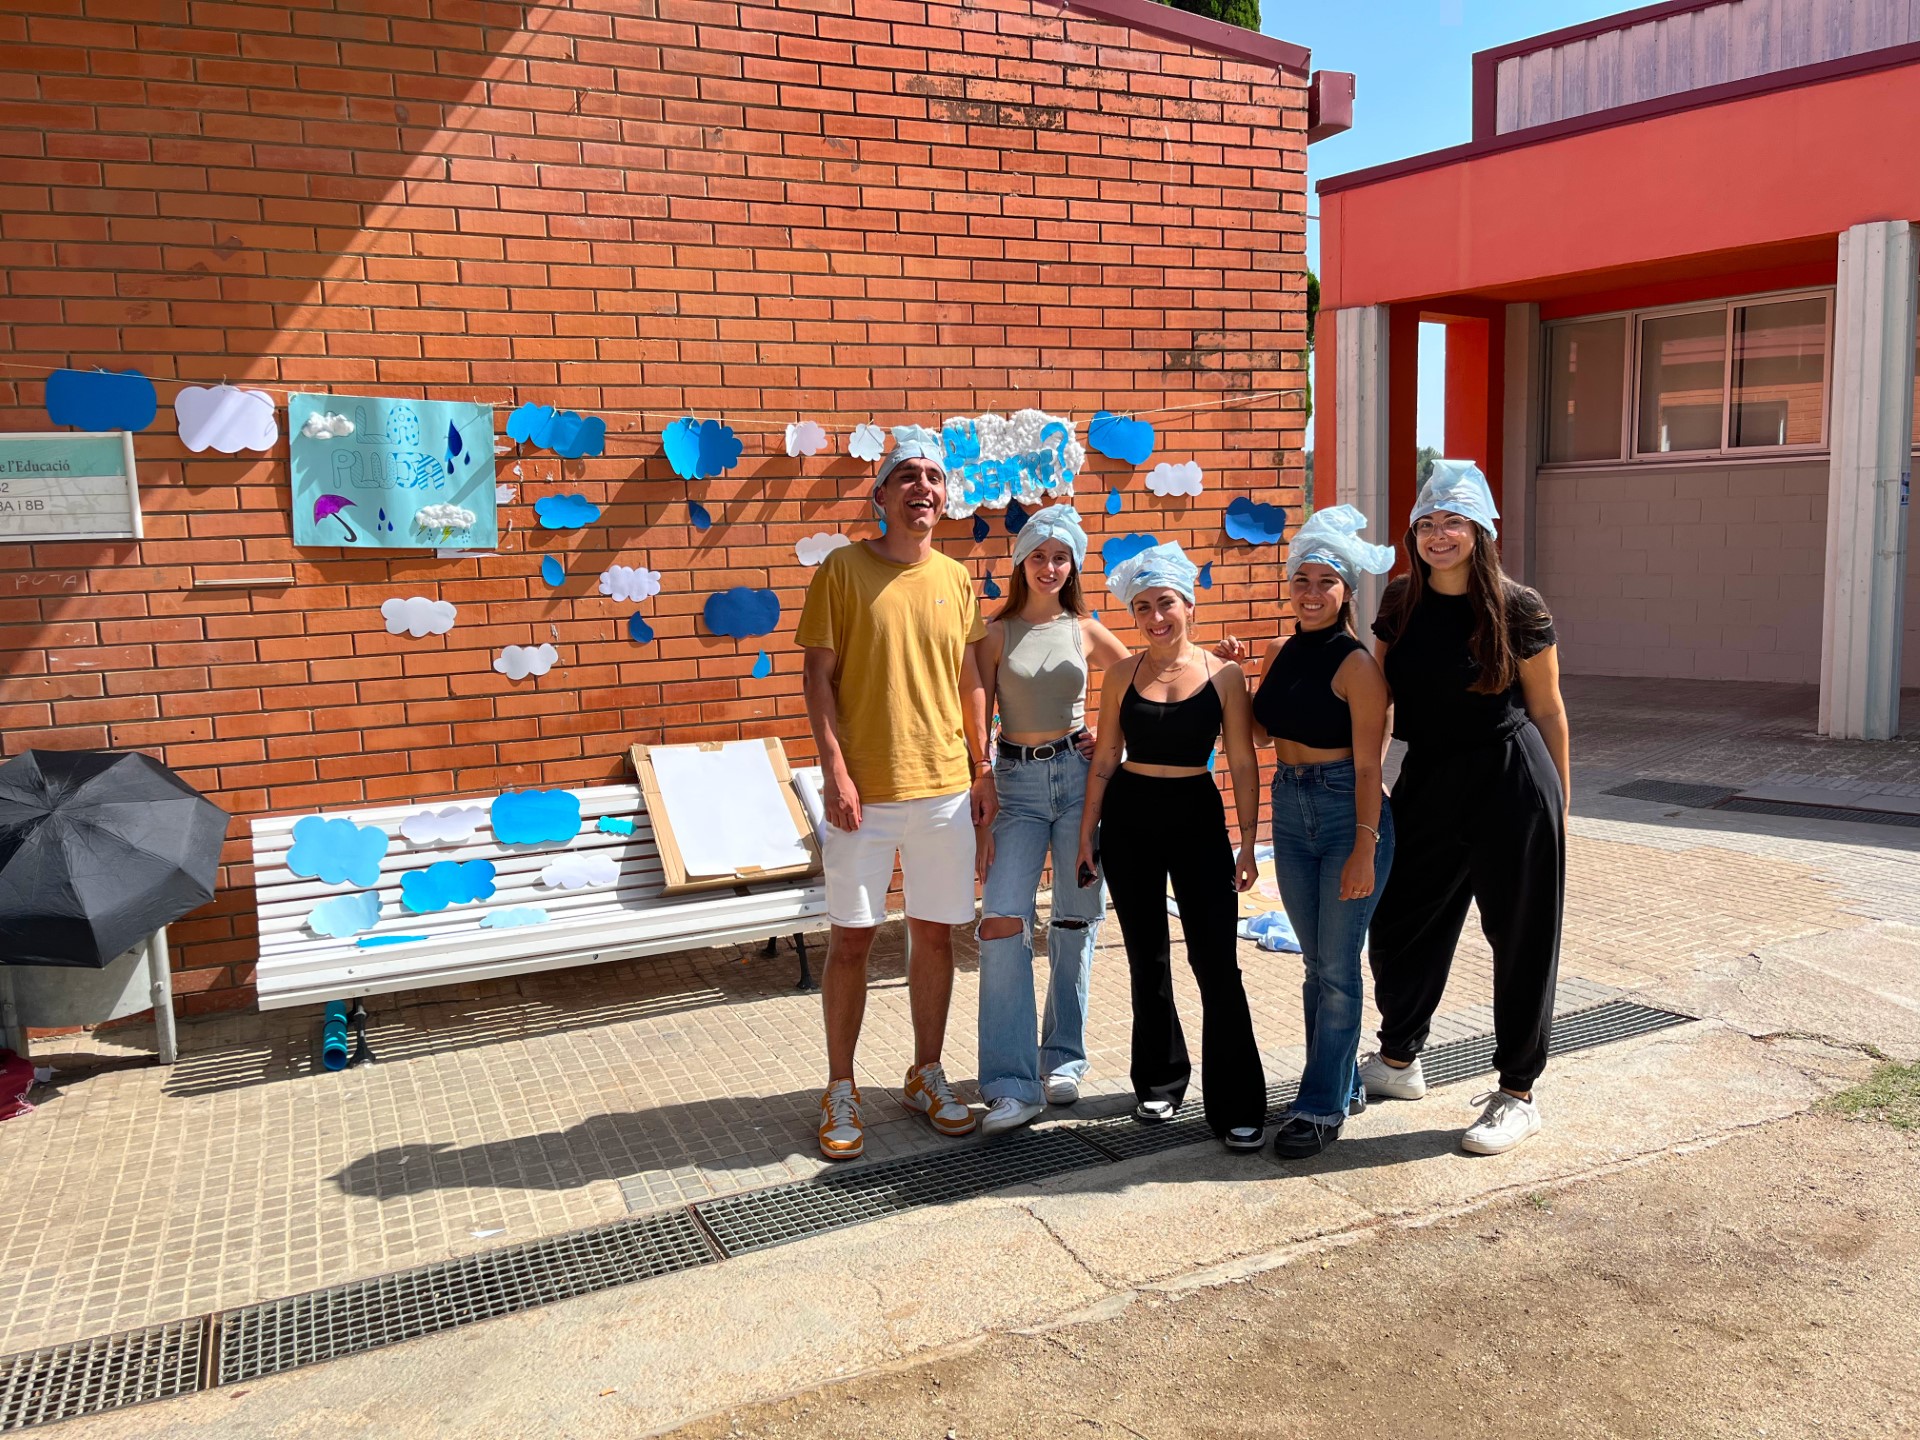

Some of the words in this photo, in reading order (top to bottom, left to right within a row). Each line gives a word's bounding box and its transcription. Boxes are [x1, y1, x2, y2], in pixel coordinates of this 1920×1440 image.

[355, 405, 420, 446] LA
[8, 460, 70, 472] l'Educació
[331, 449, 445, 490] PLUJA
[963, 421, 1074, 505] SEMPRE?
[0, 482, 9, 493] 2
[17, 500, 21, 511] i
[25, 499, 44, 511] 8B
